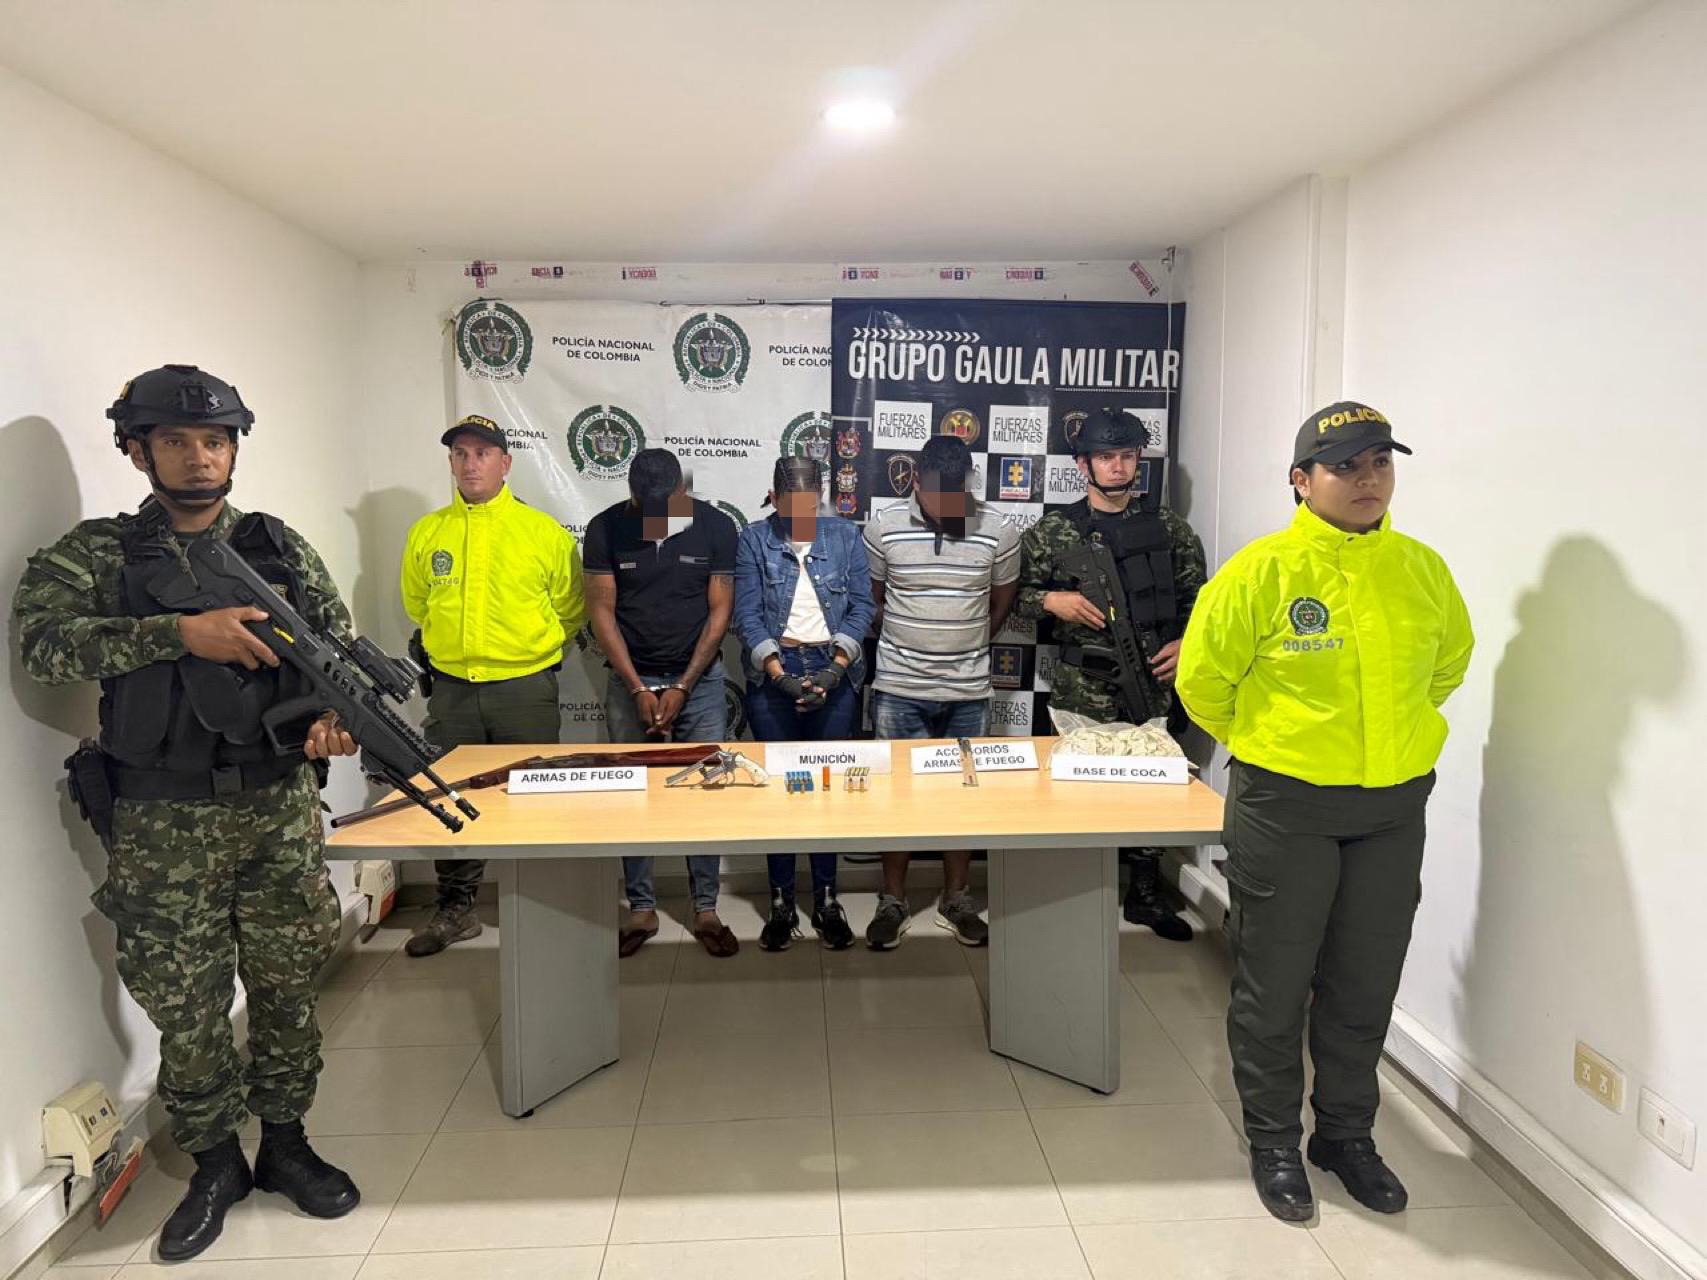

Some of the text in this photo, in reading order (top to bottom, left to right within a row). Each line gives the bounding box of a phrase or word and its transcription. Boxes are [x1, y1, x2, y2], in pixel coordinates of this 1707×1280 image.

[552, 336, 655, 352] POLICÍA NACIONAL
[769, 343, 809, 354] POLICÍA
[567, 349, 641, 362] DE COLOMBIA
[782, 358, 832, 366] DE COLO
[849, 340, 1180, 388] GRUPO GAULA MILITAR
[879, 413, 925, 427] FUERZAS
[994, 417, 1041, 431] FUERZAS
[500, 428, 548, 439] ACIONAL
[877, 427, 927, 440] MILITARES
[992, 431, 1043, 443] MILITARES
[507, 440, 534, 450] MBIA
[664, 435, 762, 449] POLICÍA NACIONAL
[678, 447, 749, 459] DE COLOMBIA
[1050, 467, 1085, 481] FUER
[1049, 481, 1088, 493] MILITAR
[1004, 619, 1032, 633] TARES
[1283, 638, 1344, 652] 008547
[935, 745, 1009, 757] ACCORIOS
[799, 752, 856, 765] MUNICIÓN
[985, 755, 1025, 766] FUEGO
[521, 770, 634, 783] ARMAS DE FUEGO
[1073, 767, 1167, 778] BASE DE COCA
